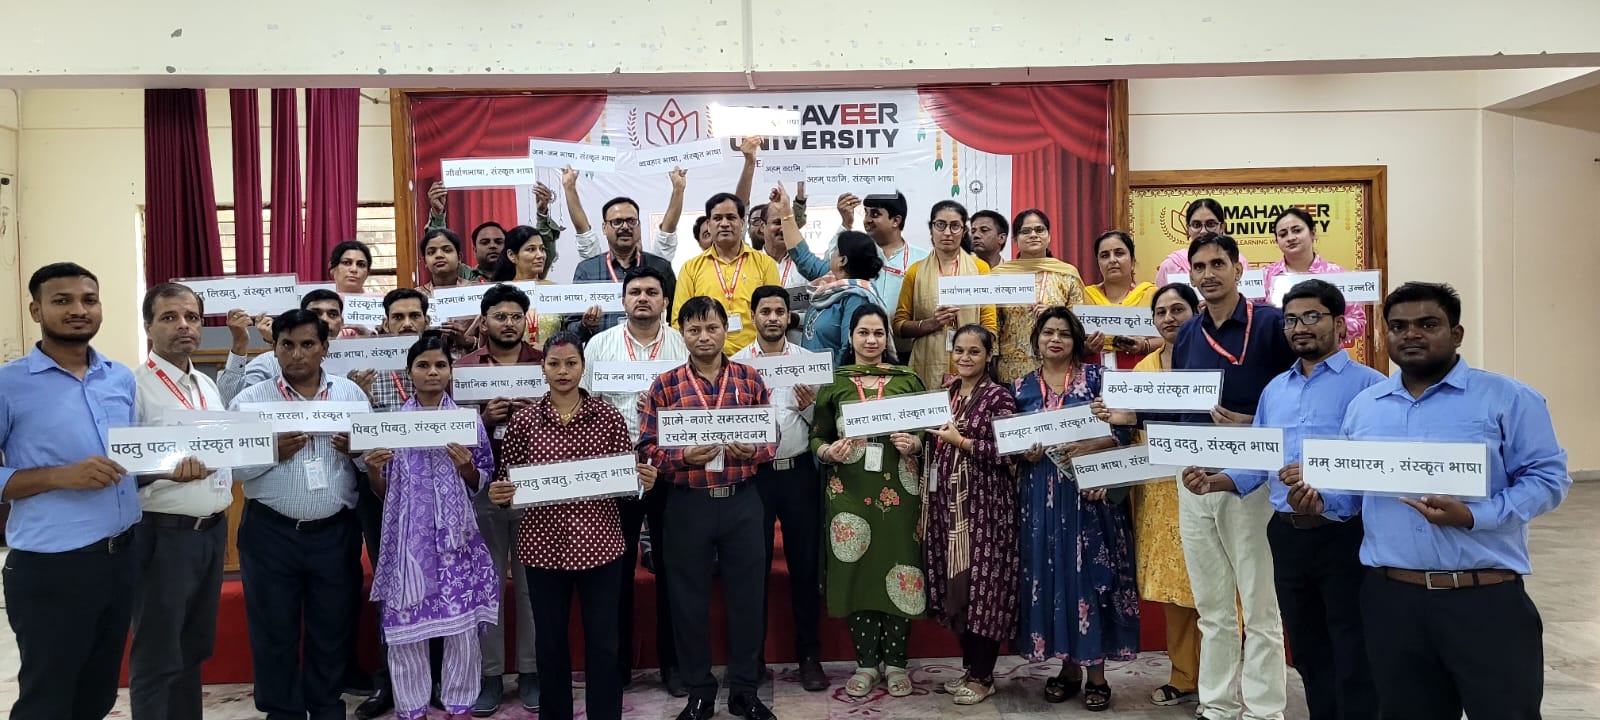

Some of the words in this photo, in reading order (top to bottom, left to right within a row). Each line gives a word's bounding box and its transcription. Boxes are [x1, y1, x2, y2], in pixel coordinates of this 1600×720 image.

[579, 154, 600, 163] संस्कृत
[601, 155, 616, 163] भाषा
[683, 151, 705, 162] संस्कृत
[706, 148, 721, 157] भाषा
[853, 157, 879, 166] LIMIT
[491, 166, 515, 178] संस्कृत
[516, 167, 534, 175] भाषा
[807, 175, 824, 185] अहम्
[853, 173, 876, 185] संस्कृत
[878, 175, 895, 183] भाषा
[994, 285, 1017, 295] संस्कृत
[1244, 280, 1264, 288] भाषा
[207, 288, 240, 299] लिखतु,
[243, 286, 272, 297] संस्कृत
[274, 285, 295, 294] भाषा
[589, 292, 615, 302] संस्कृत
[1124, 314, 1141, 328] कृते
[370, 347, 397, 358] संस्कृत
[775, 364, 805, 376] संस्कृत
[808, 363, 831, 372] भाषा
[515, 377, 542, 388] संस्कृत
[594, 372, 609, 381] प्रिय
[611, 373, 625, 381] जन
[1156, 382, 1190, 397] संस्कृत
[1192, 384, 1217, 394] भाषा
[312, 410, 343, 421] संस्कृत
[846, 416, 870, 426] अमरा
[871, 412, 896, 422] भाषा,
[898, 409, 926, 420] संस्कृत
[927, 405, 948, 415] भाषा
[352, 423, 378, 437] पिबतु
[380, 422, 411, 435] पिबतु,
[414, 420, 447, 434] संस्कृत
[450, 421, 476, 430] रसना
[1059, 418, 1087, 429] संस्कृत
[664, 430, 699, 444] रचयेम्
[701, 430, 768, 445] संस्कृतभवनम्
[111, 443, 143, 459] पठतु
[188, 436, 234, 454] संस्कृत
[238, 436, 270, 448] भाषा
[1149, 437, 1172, 452] वदतु
[1174, 438, 1203, 453] वदतु,
[1207, 437, 1246, 455] संस्कृत
[1251, 441, 1280, 453] भाषा
[1075, 464, 1099, 475] दिव्या
[1101, 459, 1127, 470] भाषा,
[1308, 457, 1331, 473] मम्
[1334, 457, 1385, 474] आधारम्
[1399, 457, 1444, 476] संस्कृत
[1449, 461, 1482, 474] भाषा
[513, 478, 540, 491] जयतु
[541, 474, 572, 488] जयतु,
[575, 470, 608, 483] संस्कृत
[610, 466, 634, 477] भाषा
